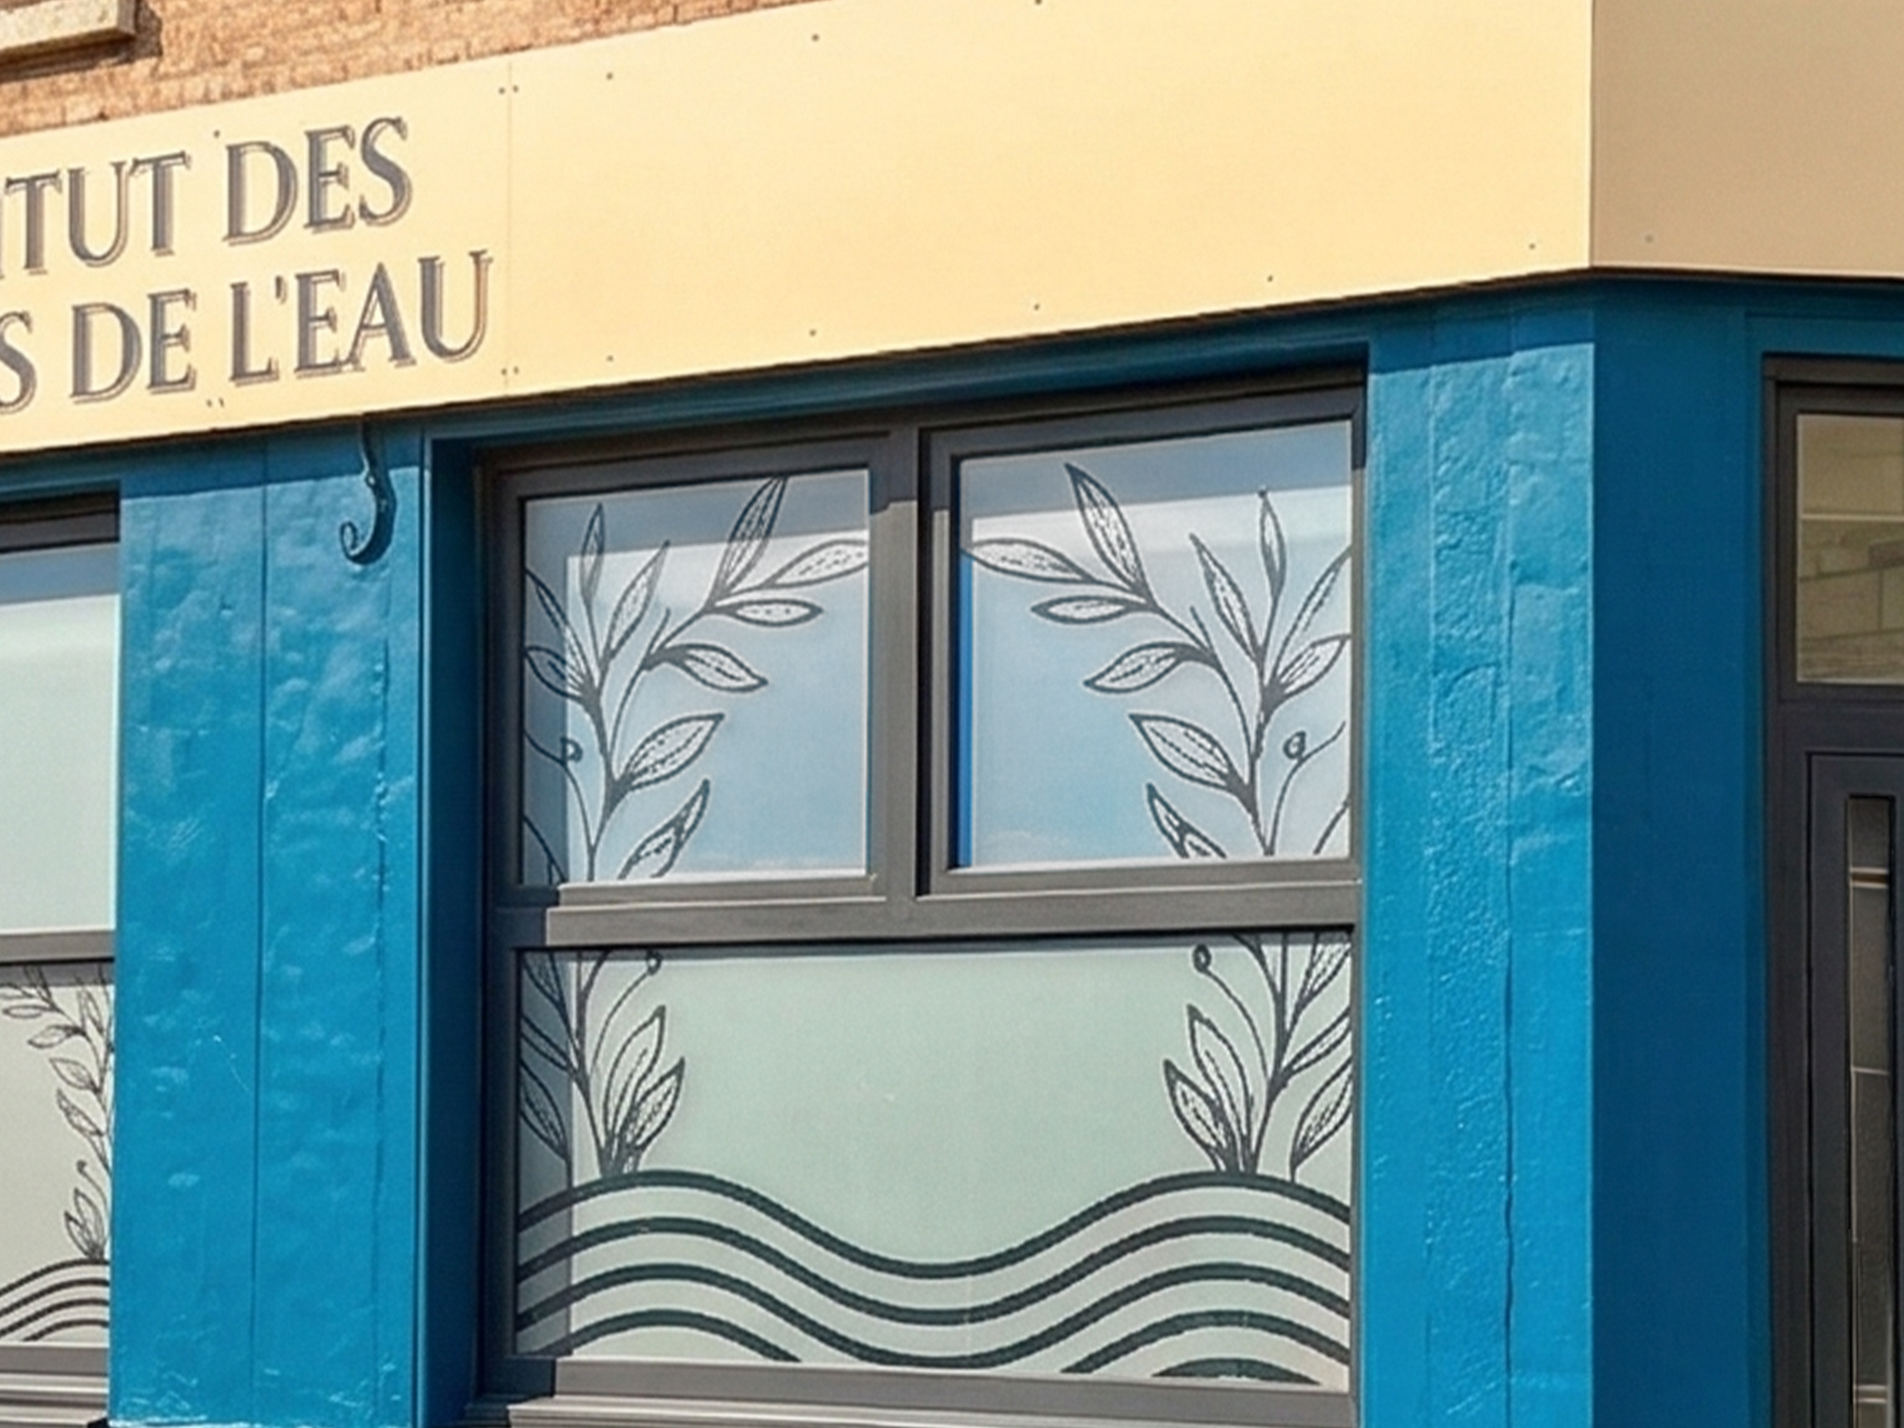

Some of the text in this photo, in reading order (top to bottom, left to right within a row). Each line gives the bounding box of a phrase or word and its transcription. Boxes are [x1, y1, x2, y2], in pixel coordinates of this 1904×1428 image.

[222, 115, 414, 246] DES
[70, 287, 198, 403] DE
[229, 248, 495, 386] L'EAU
